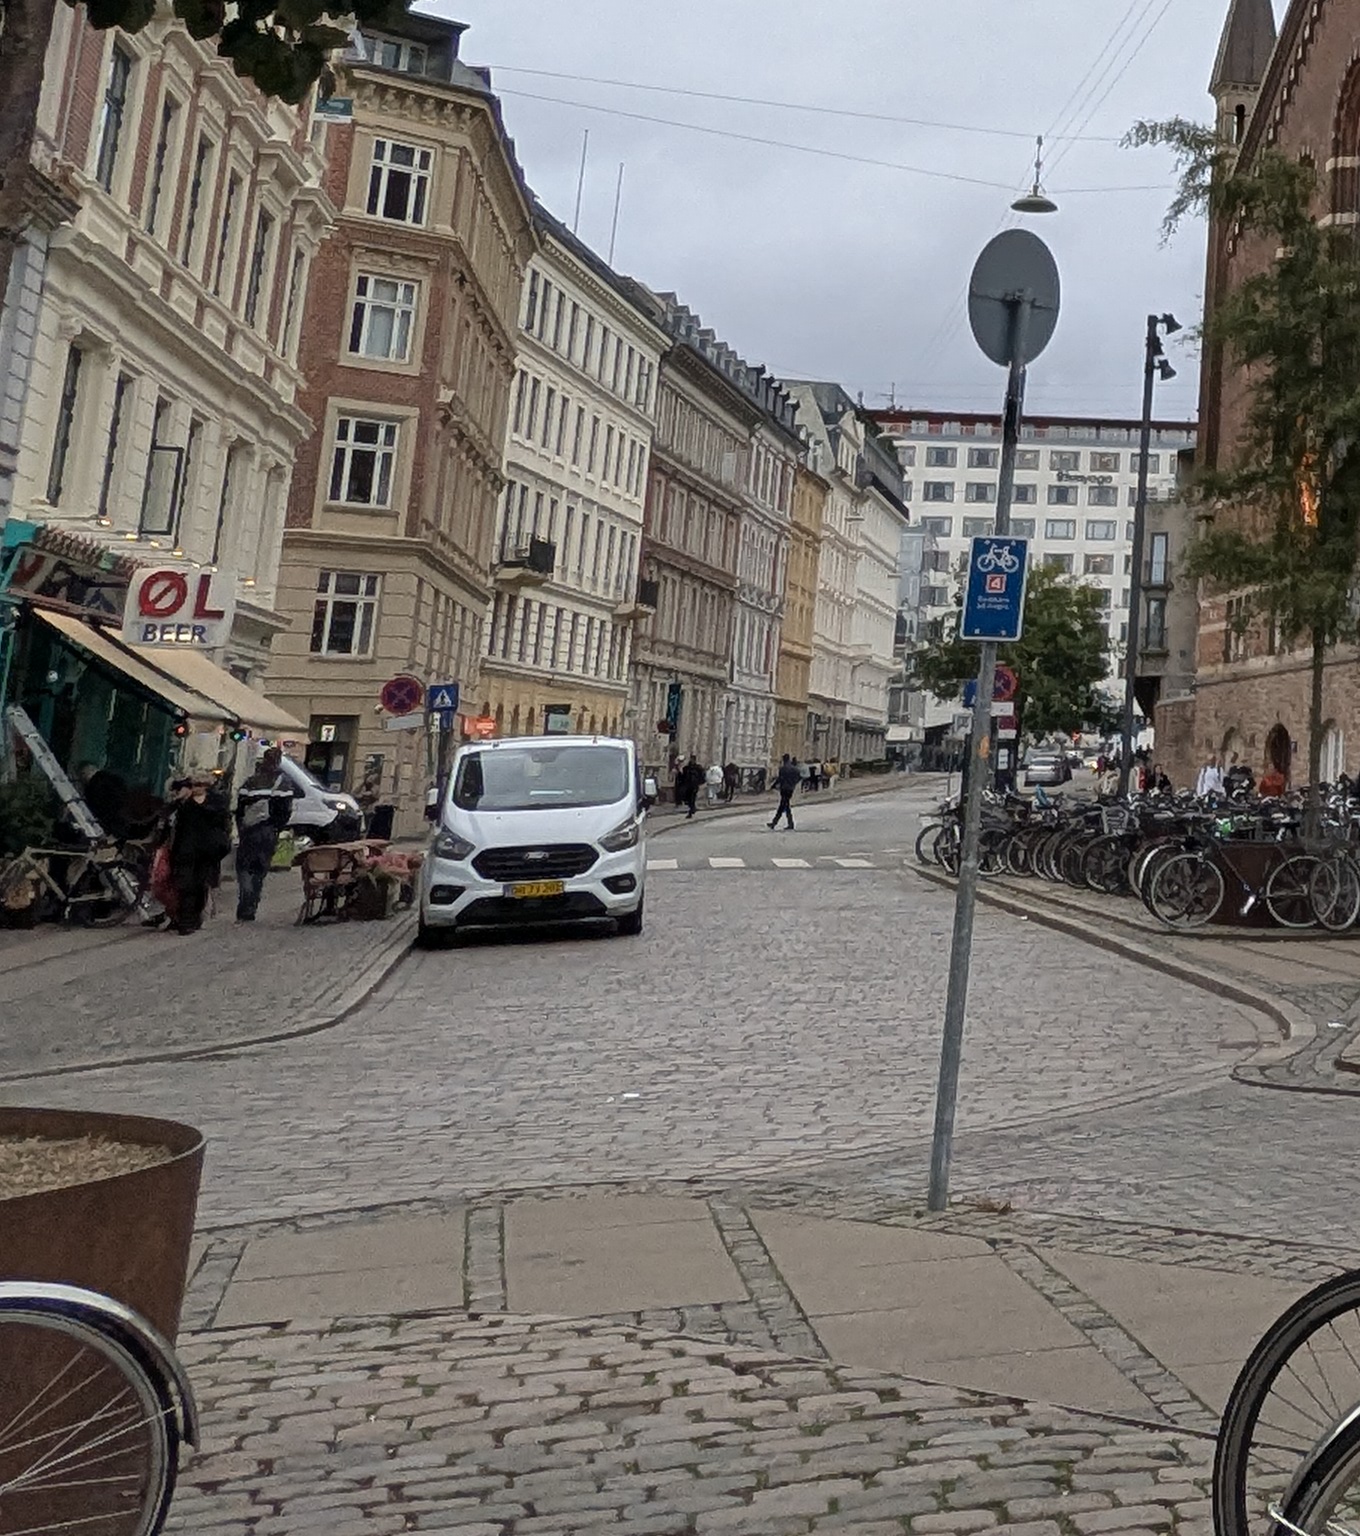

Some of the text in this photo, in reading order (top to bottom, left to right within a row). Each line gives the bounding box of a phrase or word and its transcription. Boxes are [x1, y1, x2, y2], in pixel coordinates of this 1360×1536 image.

[991, 577, 1001, 590] 4
[137, 570, 225, 620] ØL
[141, 624, 208, 644] BEER
